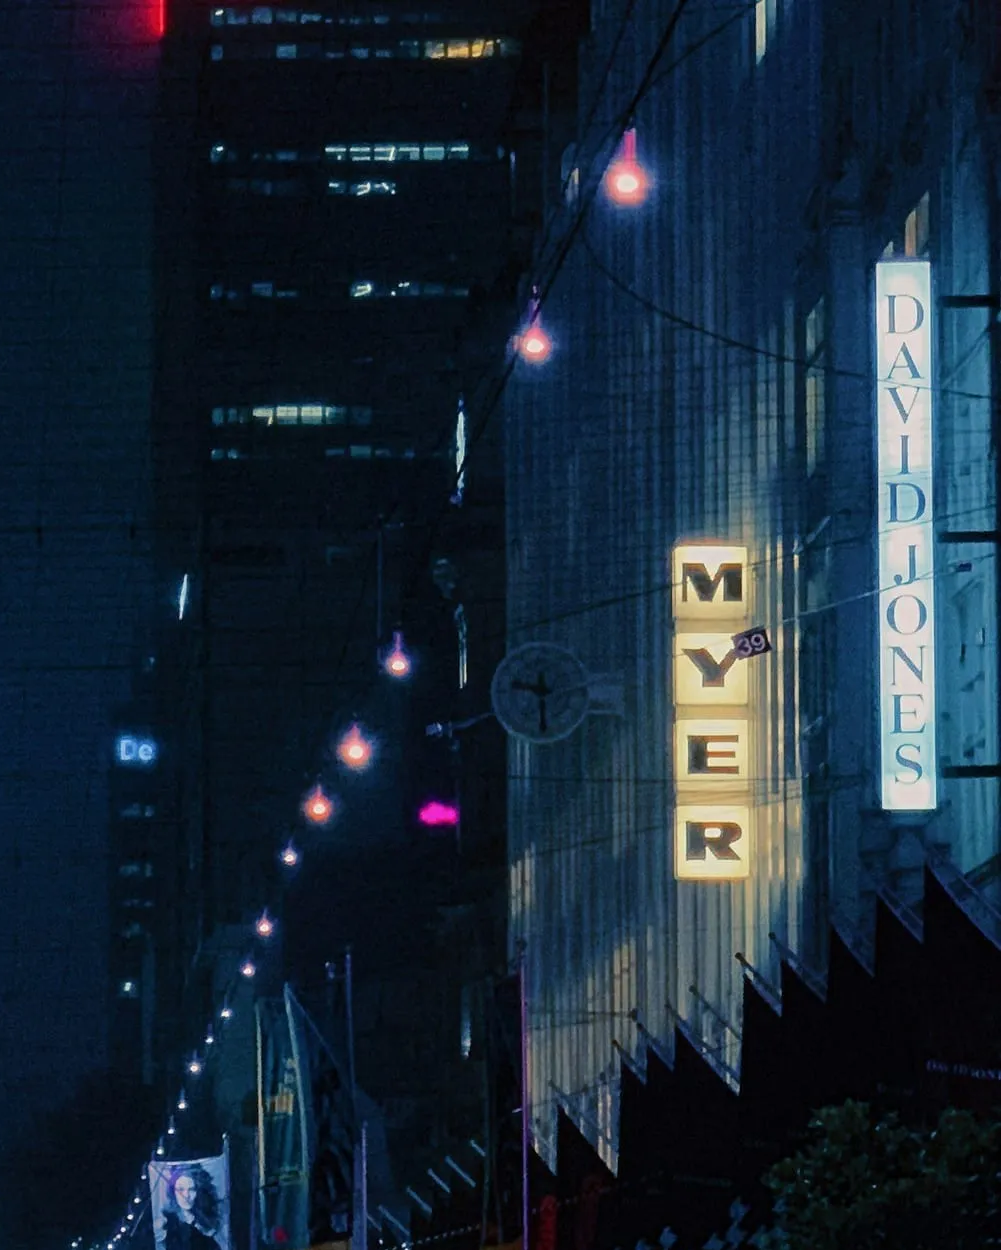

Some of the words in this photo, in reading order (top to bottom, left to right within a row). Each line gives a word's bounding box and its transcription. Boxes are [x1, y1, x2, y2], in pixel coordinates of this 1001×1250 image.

[885, 293, 926, 523] DAVID
[681, 562, 743, 861] MYER
[736, 632, 767, 656] 39
[887, 543, 928, 785] JONES
